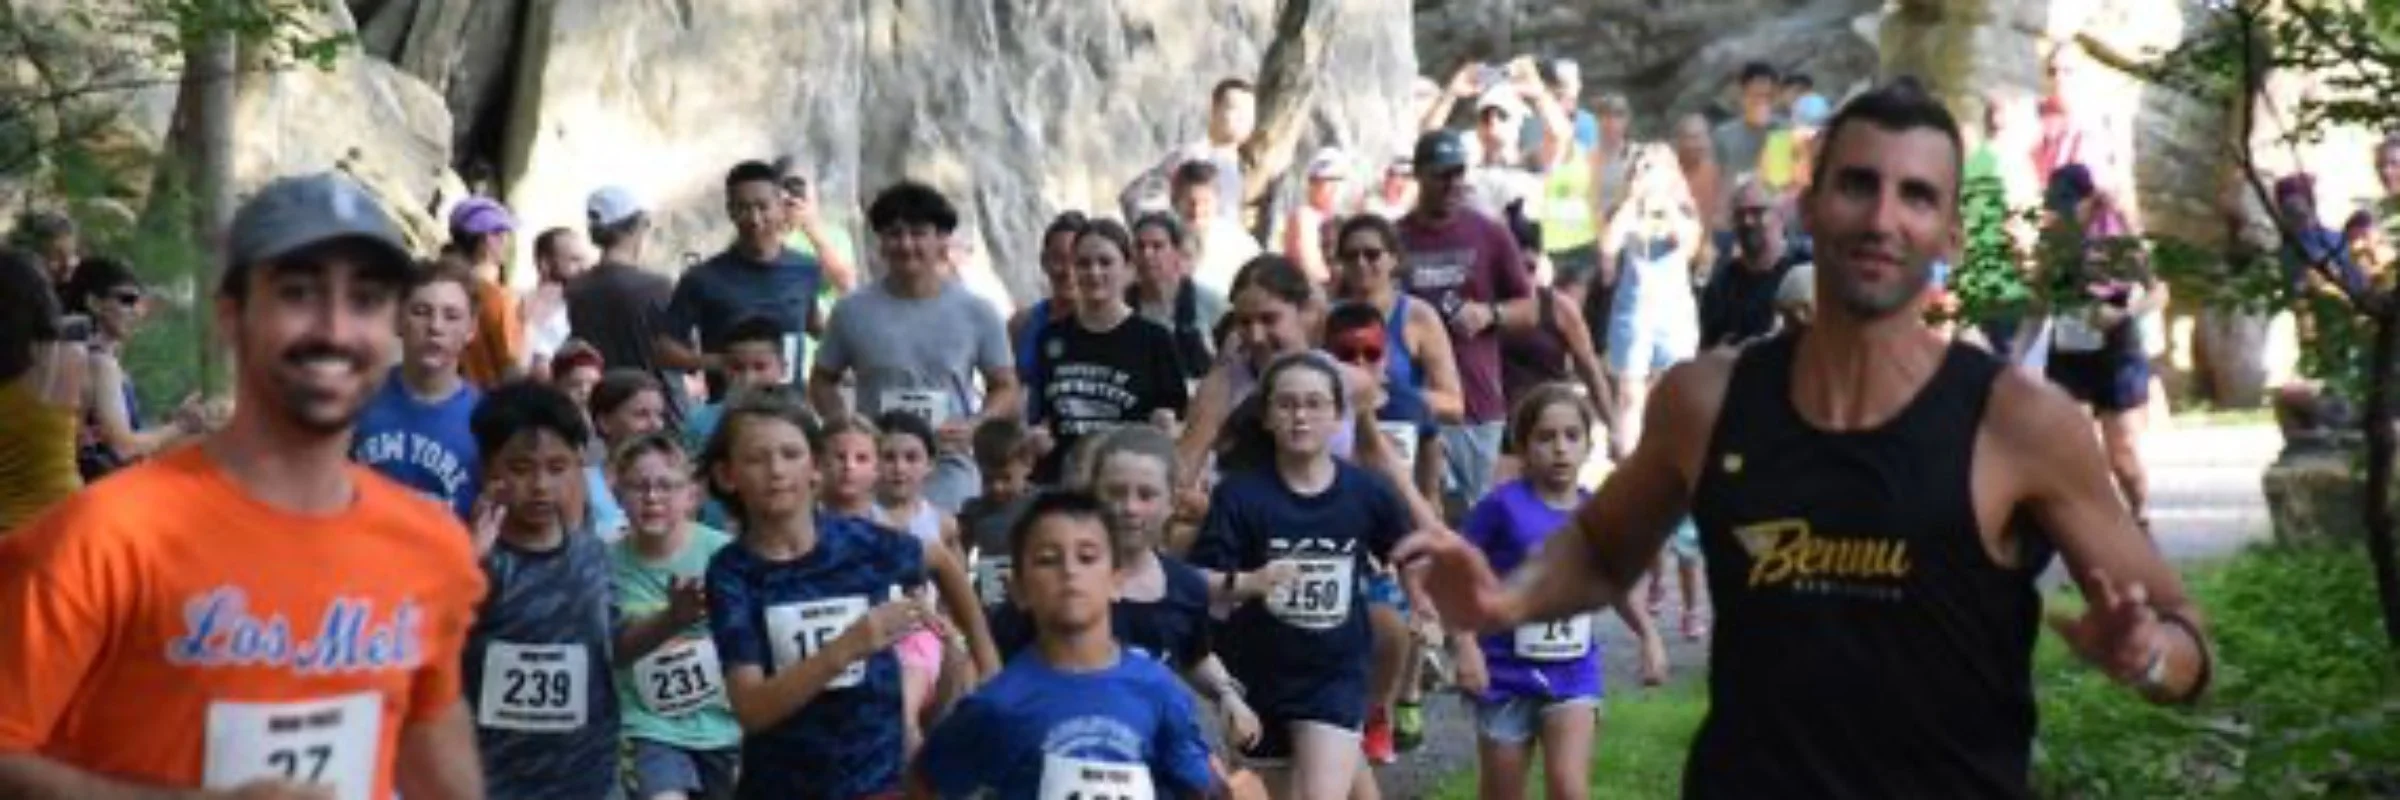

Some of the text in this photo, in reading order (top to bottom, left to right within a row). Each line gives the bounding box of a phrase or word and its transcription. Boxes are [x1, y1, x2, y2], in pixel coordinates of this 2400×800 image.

[410, 432, 469, 494] YORK
[1733, 518, 1911, 588] Bennu
[168, 586, 290, 666] Los
[502, 668, 571, 708] 239
[651, 664, 710, 700] 231
